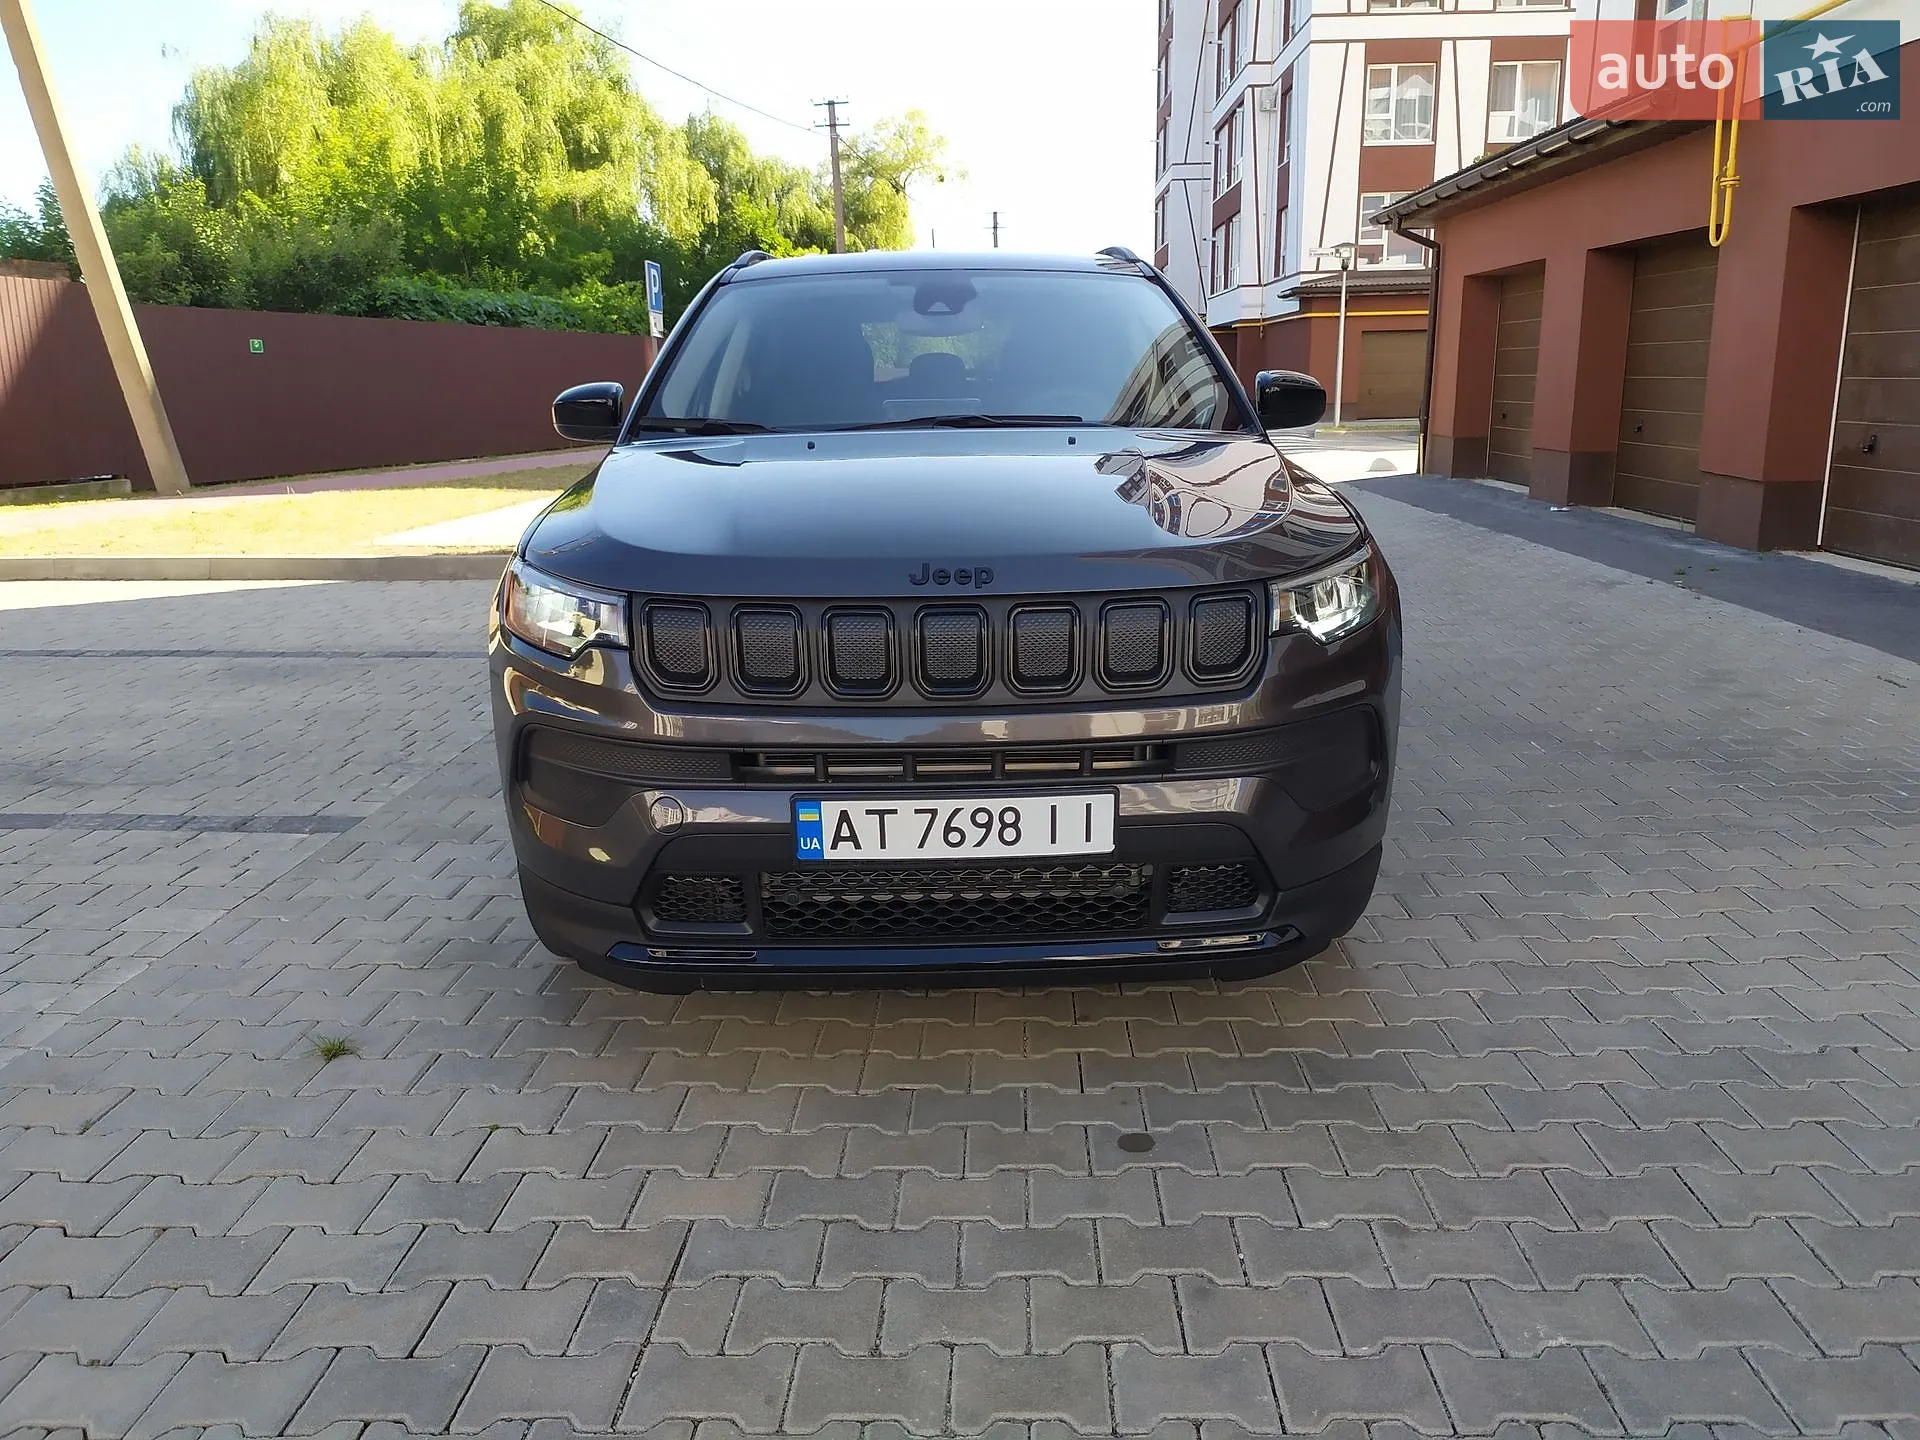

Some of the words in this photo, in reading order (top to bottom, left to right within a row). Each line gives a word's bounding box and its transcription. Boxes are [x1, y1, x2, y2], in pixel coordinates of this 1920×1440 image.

[650, 268, 659, 306] P
[908, 562, 994, 589] Jeep
[800, 837, 821, 850] UA
[829, 808, 898, 851] AT
[914, 806, 1022, 849] 7698
